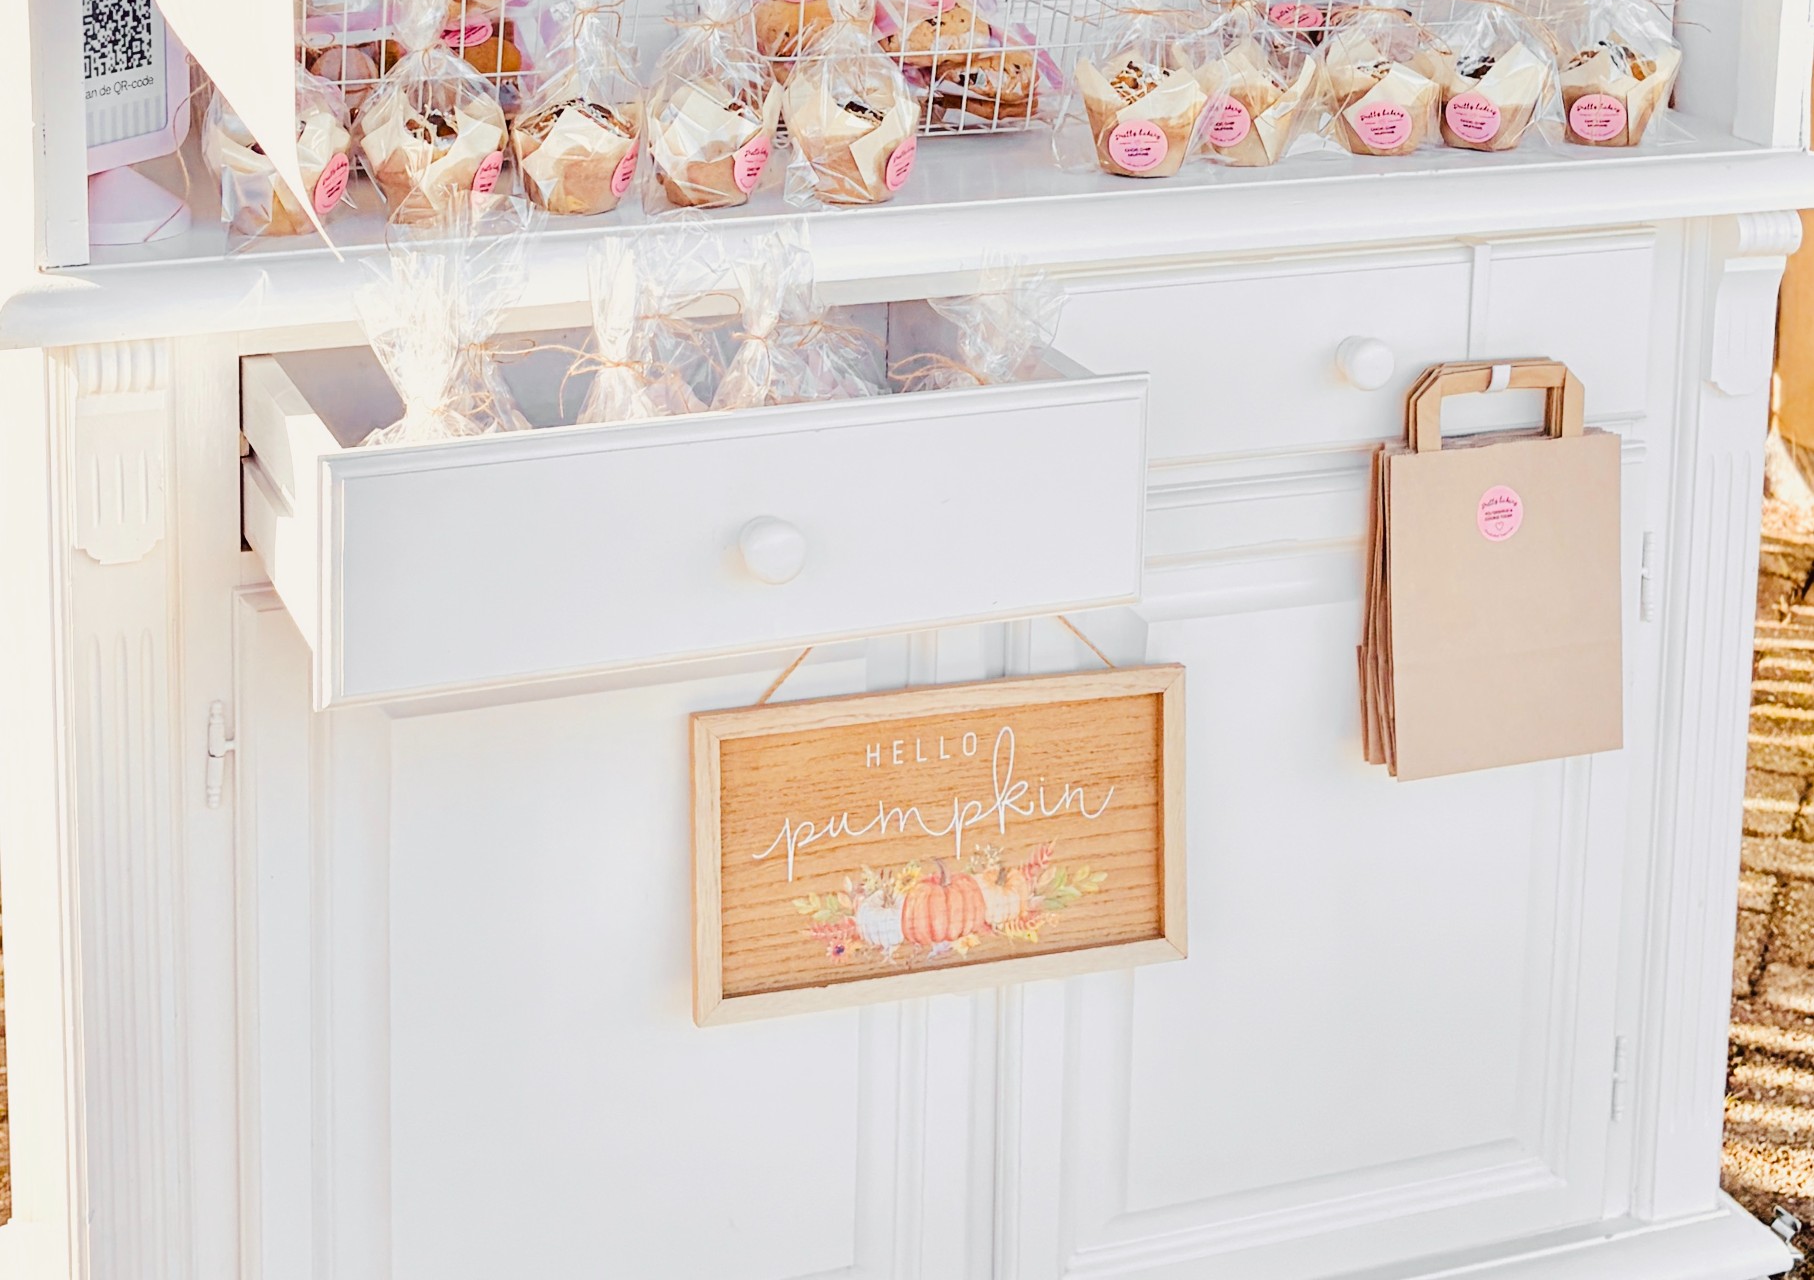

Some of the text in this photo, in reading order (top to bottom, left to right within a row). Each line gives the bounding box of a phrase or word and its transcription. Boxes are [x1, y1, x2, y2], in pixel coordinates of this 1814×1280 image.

[99, 84, 111, 96] de
[113, 75, 154, 95] QR-code
[866, 731, 978, 768] HELLO
[752, 725, 1115, 882] pumpkin
